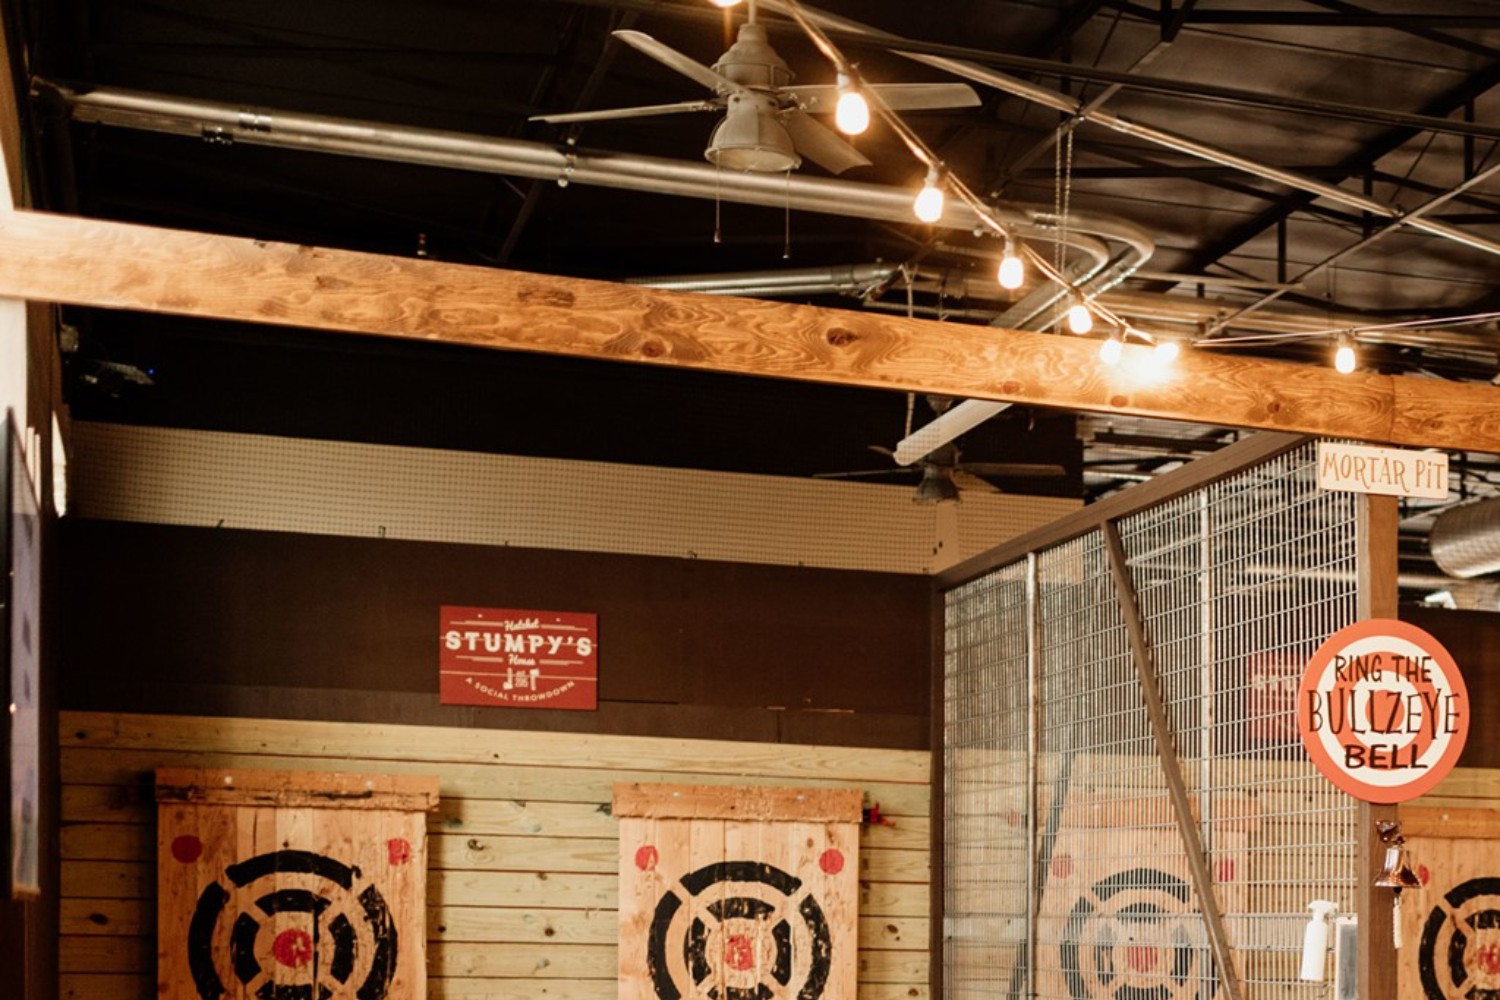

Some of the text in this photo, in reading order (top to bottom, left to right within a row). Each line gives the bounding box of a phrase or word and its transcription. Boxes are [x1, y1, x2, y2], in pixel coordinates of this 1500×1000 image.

[1322, 450, 1409, 493] MORTAR
[445, 630, 592, 656] STUMPY'S
[1334, 655, 1433, 683] RING THE
[474, 682, 509, 701] SOCIAL
[512, 680, 576, 702] THROWDOWN
[1307, 687, 1461, 741] BULLZEYE
[1344, 744, 1428, 770] BELL
